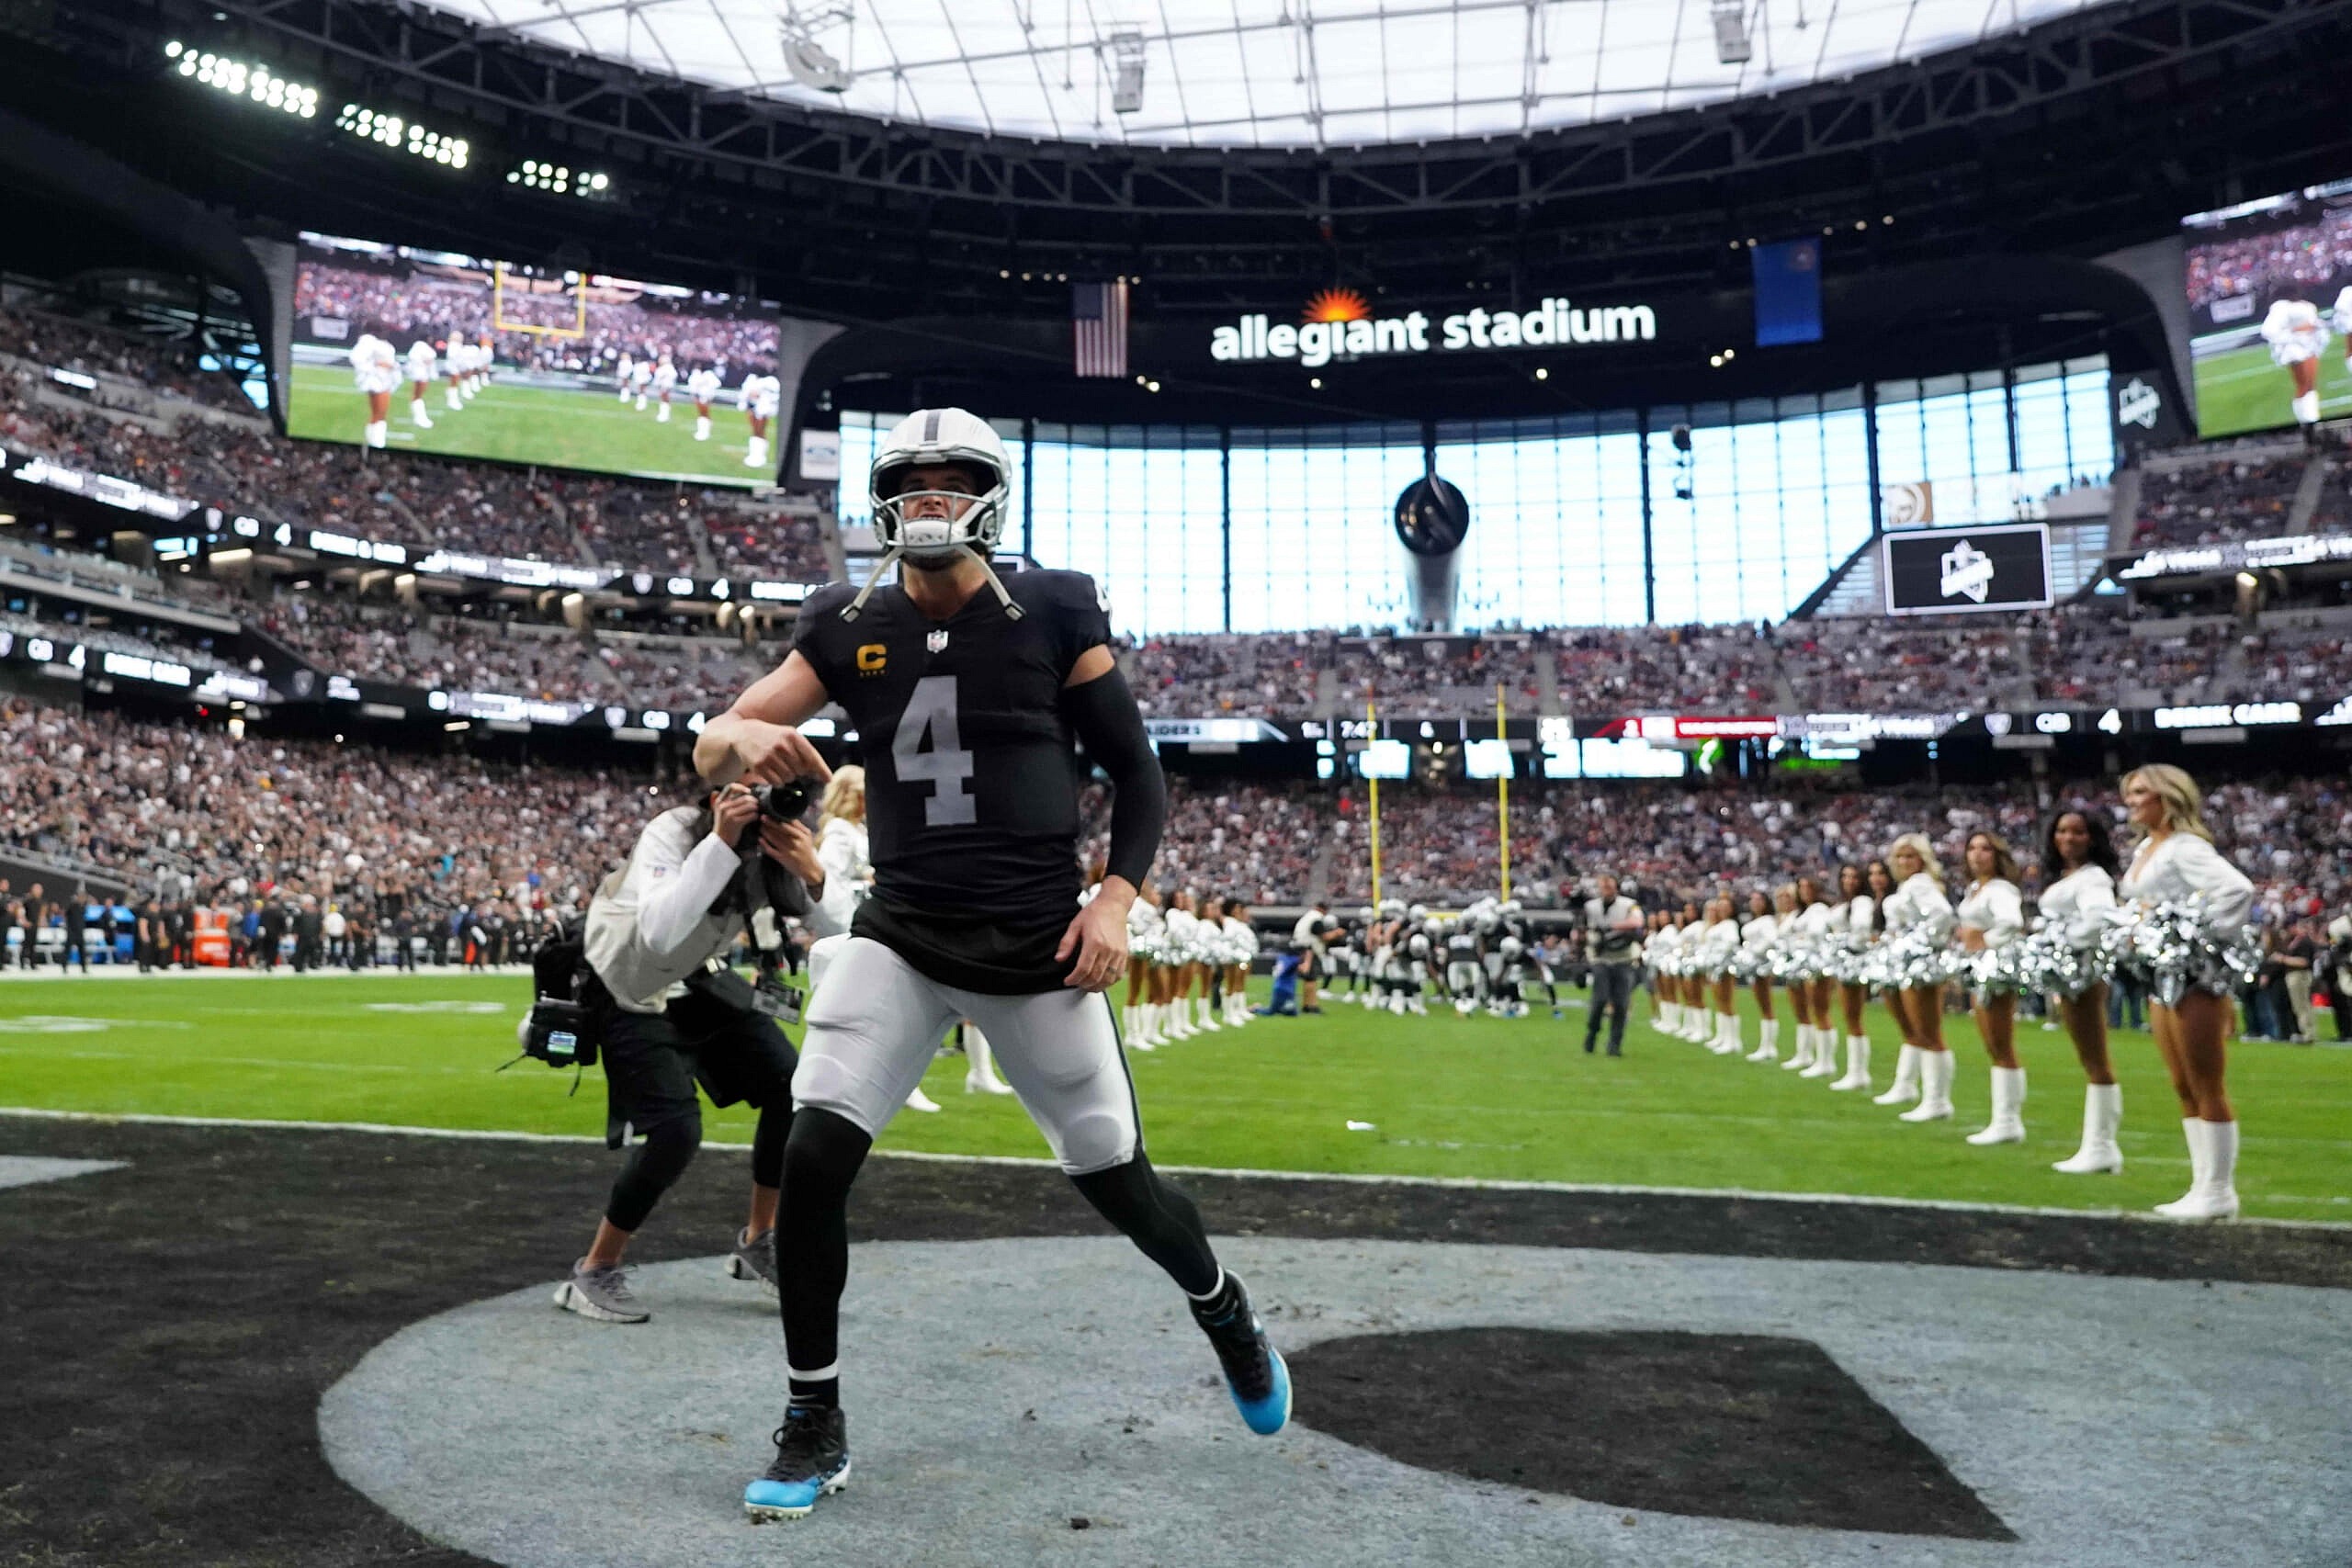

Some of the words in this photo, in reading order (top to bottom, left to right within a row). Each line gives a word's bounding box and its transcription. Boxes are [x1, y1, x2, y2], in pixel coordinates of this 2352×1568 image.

[1210, 310, 1430, 367] allegiant
[1442, 297, 1656, 349] stadium
[856, 643, 888, 671] C
[891, 675, 978, 827] 4
